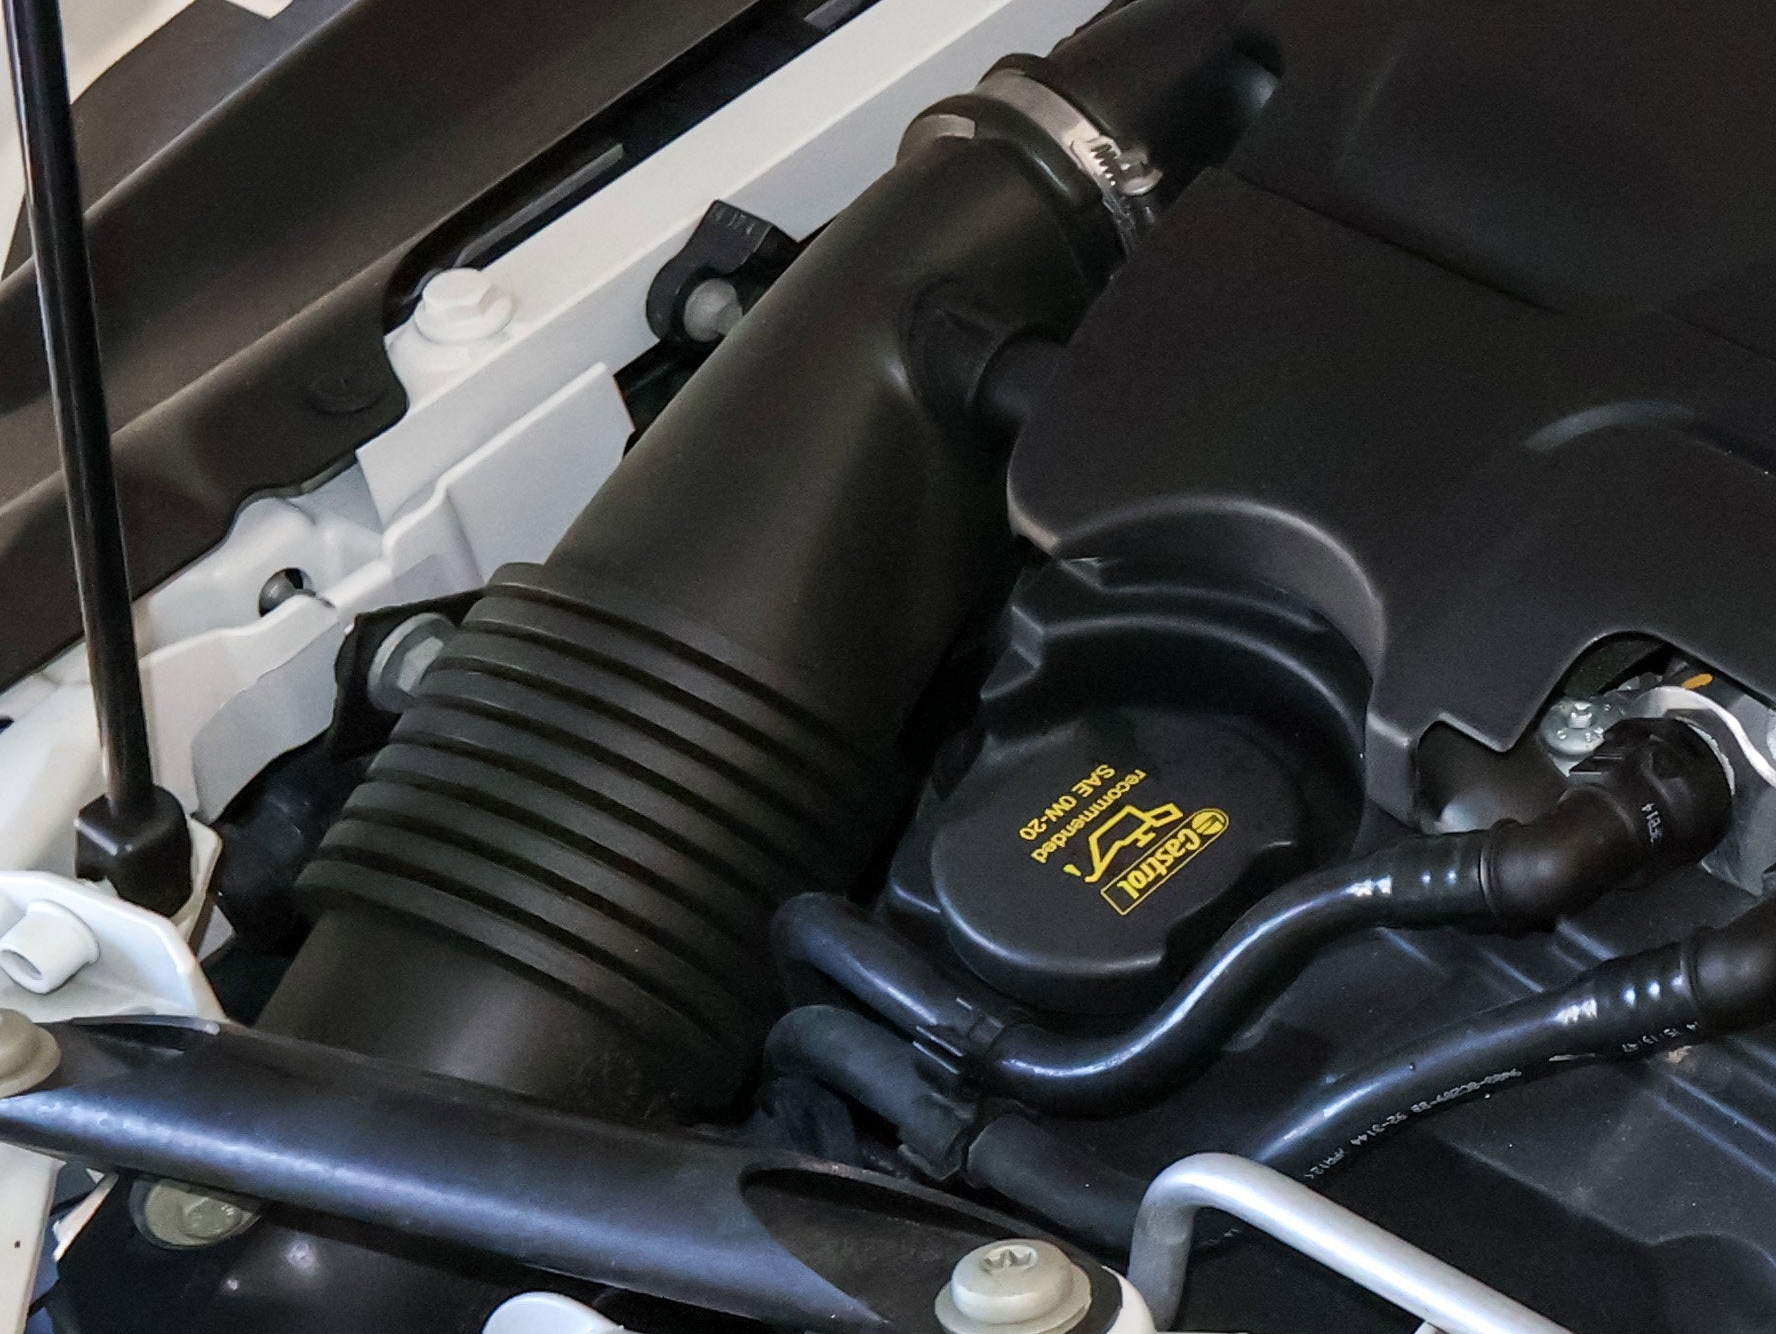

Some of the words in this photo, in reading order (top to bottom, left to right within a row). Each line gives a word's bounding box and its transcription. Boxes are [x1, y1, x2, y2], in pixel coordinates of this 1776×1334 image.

[1071, 764, 1115, 798] SAE
[1018, 795, 1078, 841] 0W-20
[1030, 769, 1147, 863] recommended
[1115, 828, 1202, 900] Castrol
